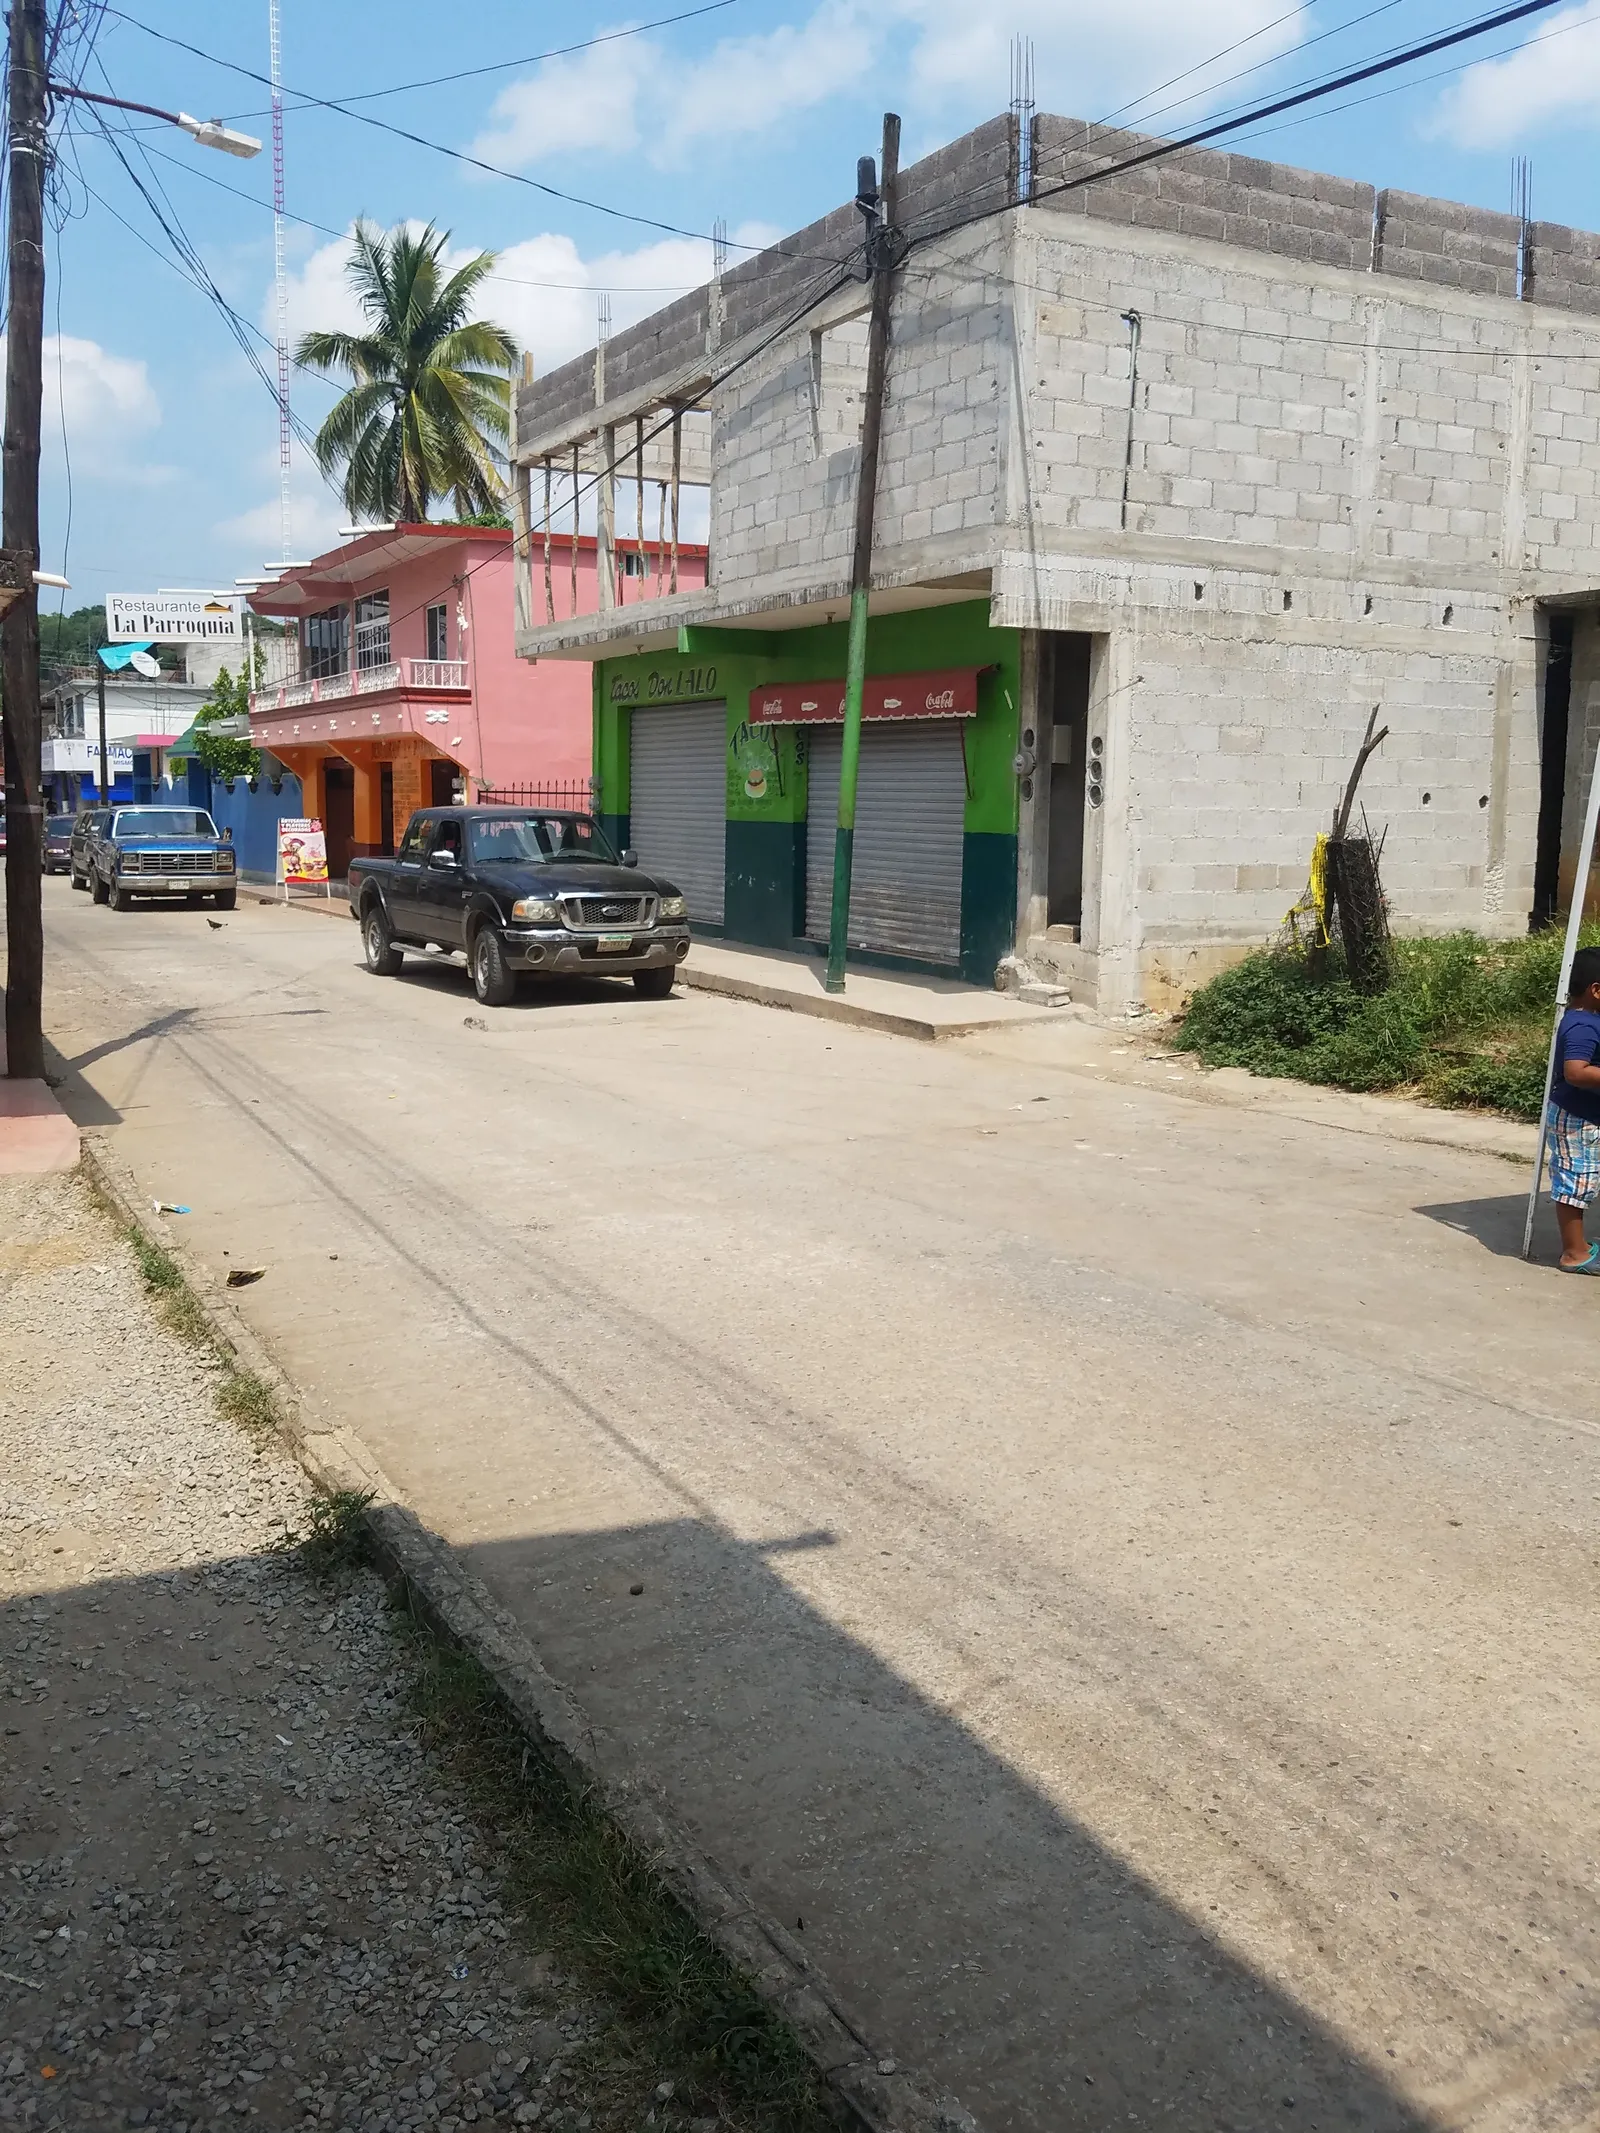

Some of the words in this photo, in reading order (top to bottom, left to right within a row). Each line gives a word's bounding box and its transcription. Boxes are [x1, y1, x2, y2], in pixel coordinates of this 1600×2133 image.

[112, 598, 201, 613] Restaurante
[113, 614, 136, 633] La
[143, 614, 235, 638] Parroquia
